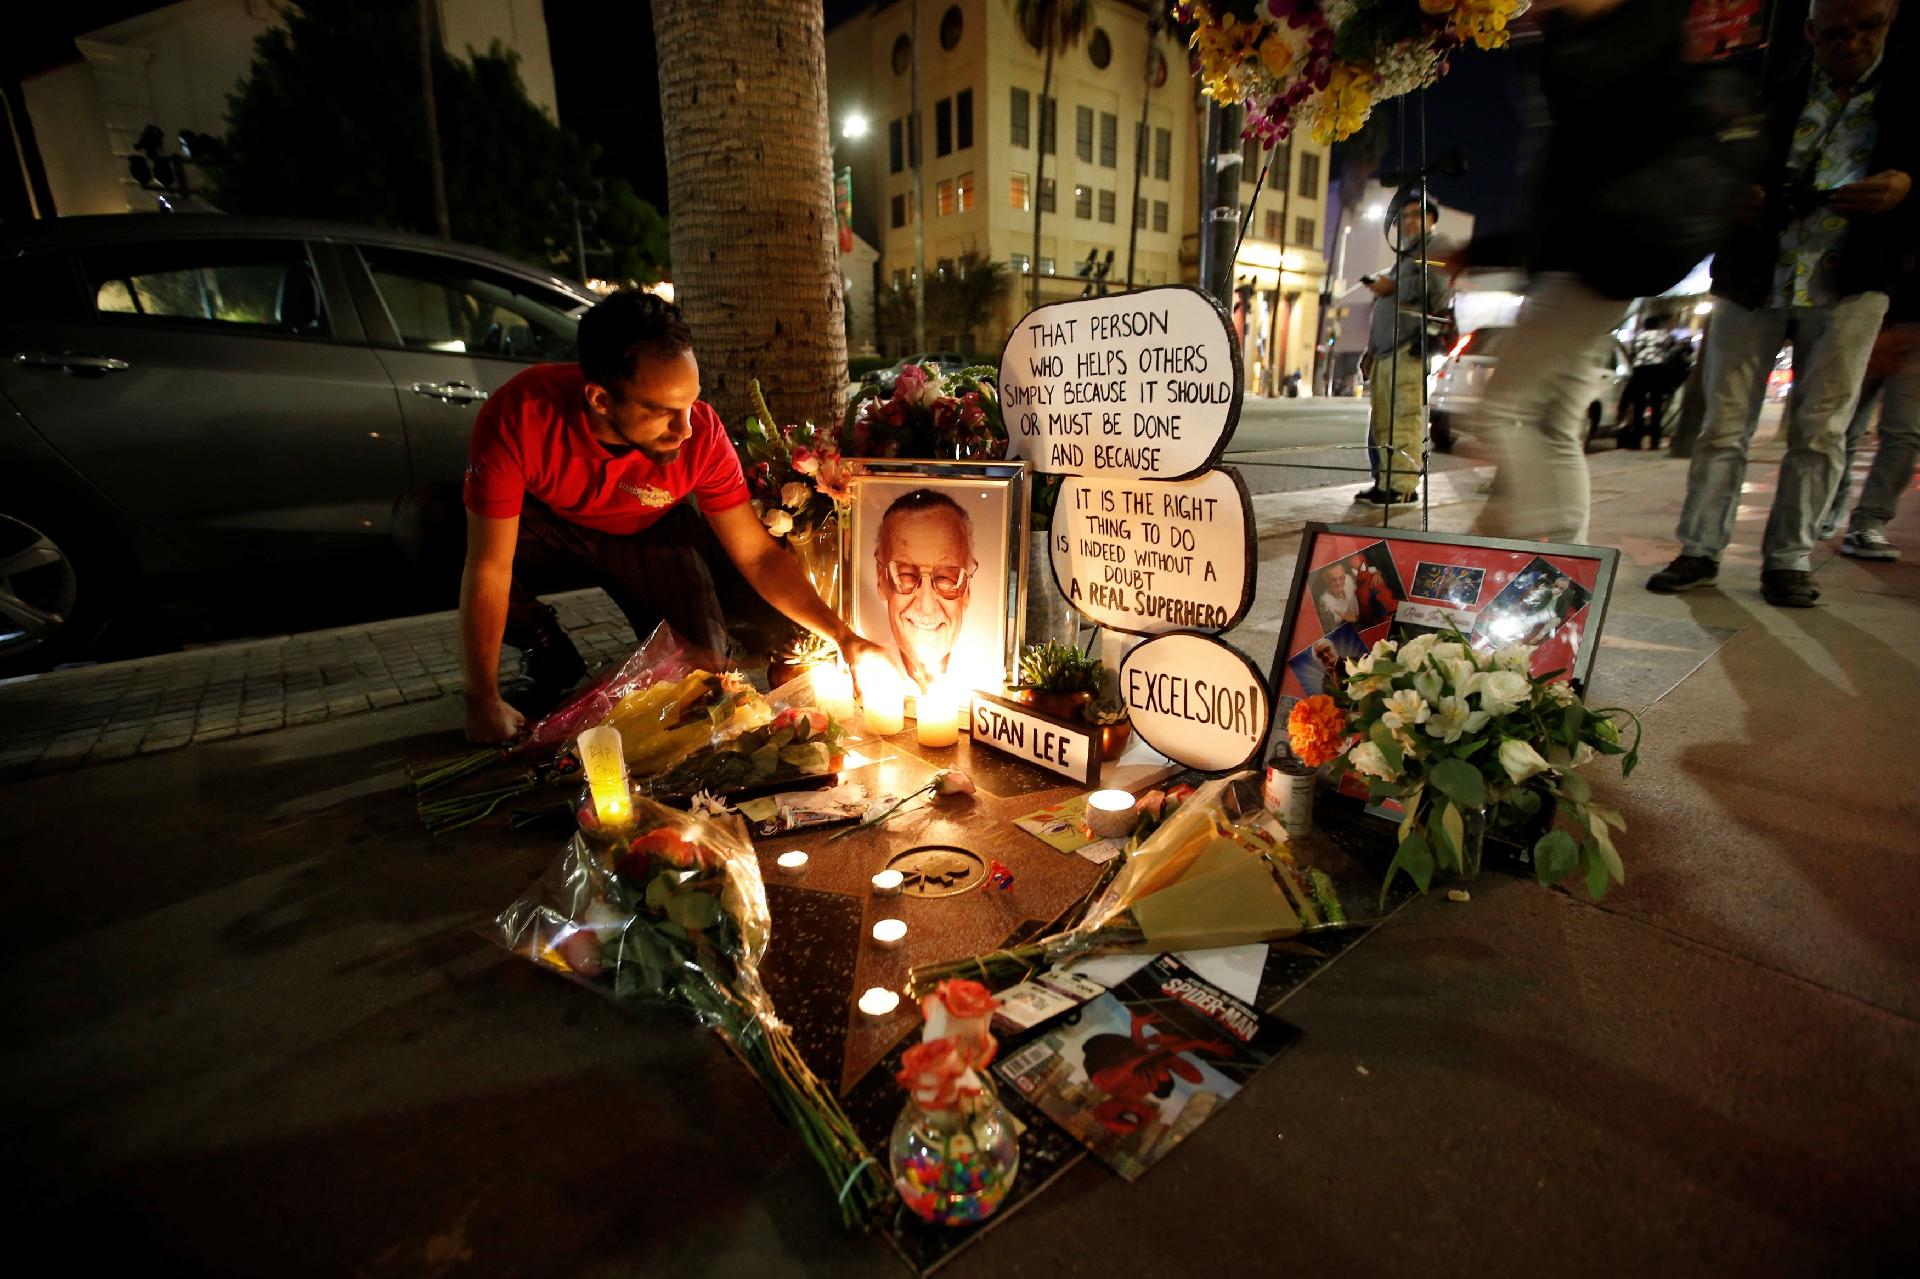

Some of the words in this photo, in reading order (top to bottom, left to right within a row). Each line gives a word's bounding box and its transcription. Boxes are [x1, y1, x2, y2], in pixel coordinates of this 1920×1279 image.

[1029, 319, 1078, 348] THAT
[1091, 310, 1168, 340] PERSON
[1030, 356, 1064, 378] WHO
[1077, 350, 1127, 379] HELPS
[1139, 344, 1208, 374] OTHERS
[1004, 384, 1055, 408] SIMPLY
[1064, 381, 1127, 403] BECAUSE
[1140, 381, 1158, 402] IT
[1167, 380, 1231, 404] SHOULD
[1020, 413, 1040, 436] OR
[1048, 412, 1092, 436] MUST
[1102, 413, 1122, 436] BE
[1134, 415, 1182, 440] DONE
[1051, 444, 1084, 467] AND
[1094, 446, 1160, 472] BECAUSE
[1076, 488, 1091, 510] IT
[1101, 490, 1115, 512] IS
[1121, 491, 1154, 515] THE
[1164, 494, 1217, 522] RIGHT
[1086, 516, 1131, 540] THING
[1142, 523, 1160, 545] TO
[1171, 527, 1195, 551] DO
[1057, 536, 1069, 553] IS
[1080, 539, 1125, 563] INDEED
[1134, 550, 1193, 576] WITHOUT
[1204, 561, 1216, 582] A
[1105, 565, 1154, 591] DOUBT
[1071, 577, 1082, 600] A
[1090, 582, 1130, 612] REAL
[1134, 590, 1228, 628] SUPERHERO
[1129, 668, 1258, 743] EXCELSIOR!
[978, 707, 1024, 749] STAN
[1033, 727, 1071, 768] LEE
[1161, 978, 1259, 1042] SPIDER-MAN
